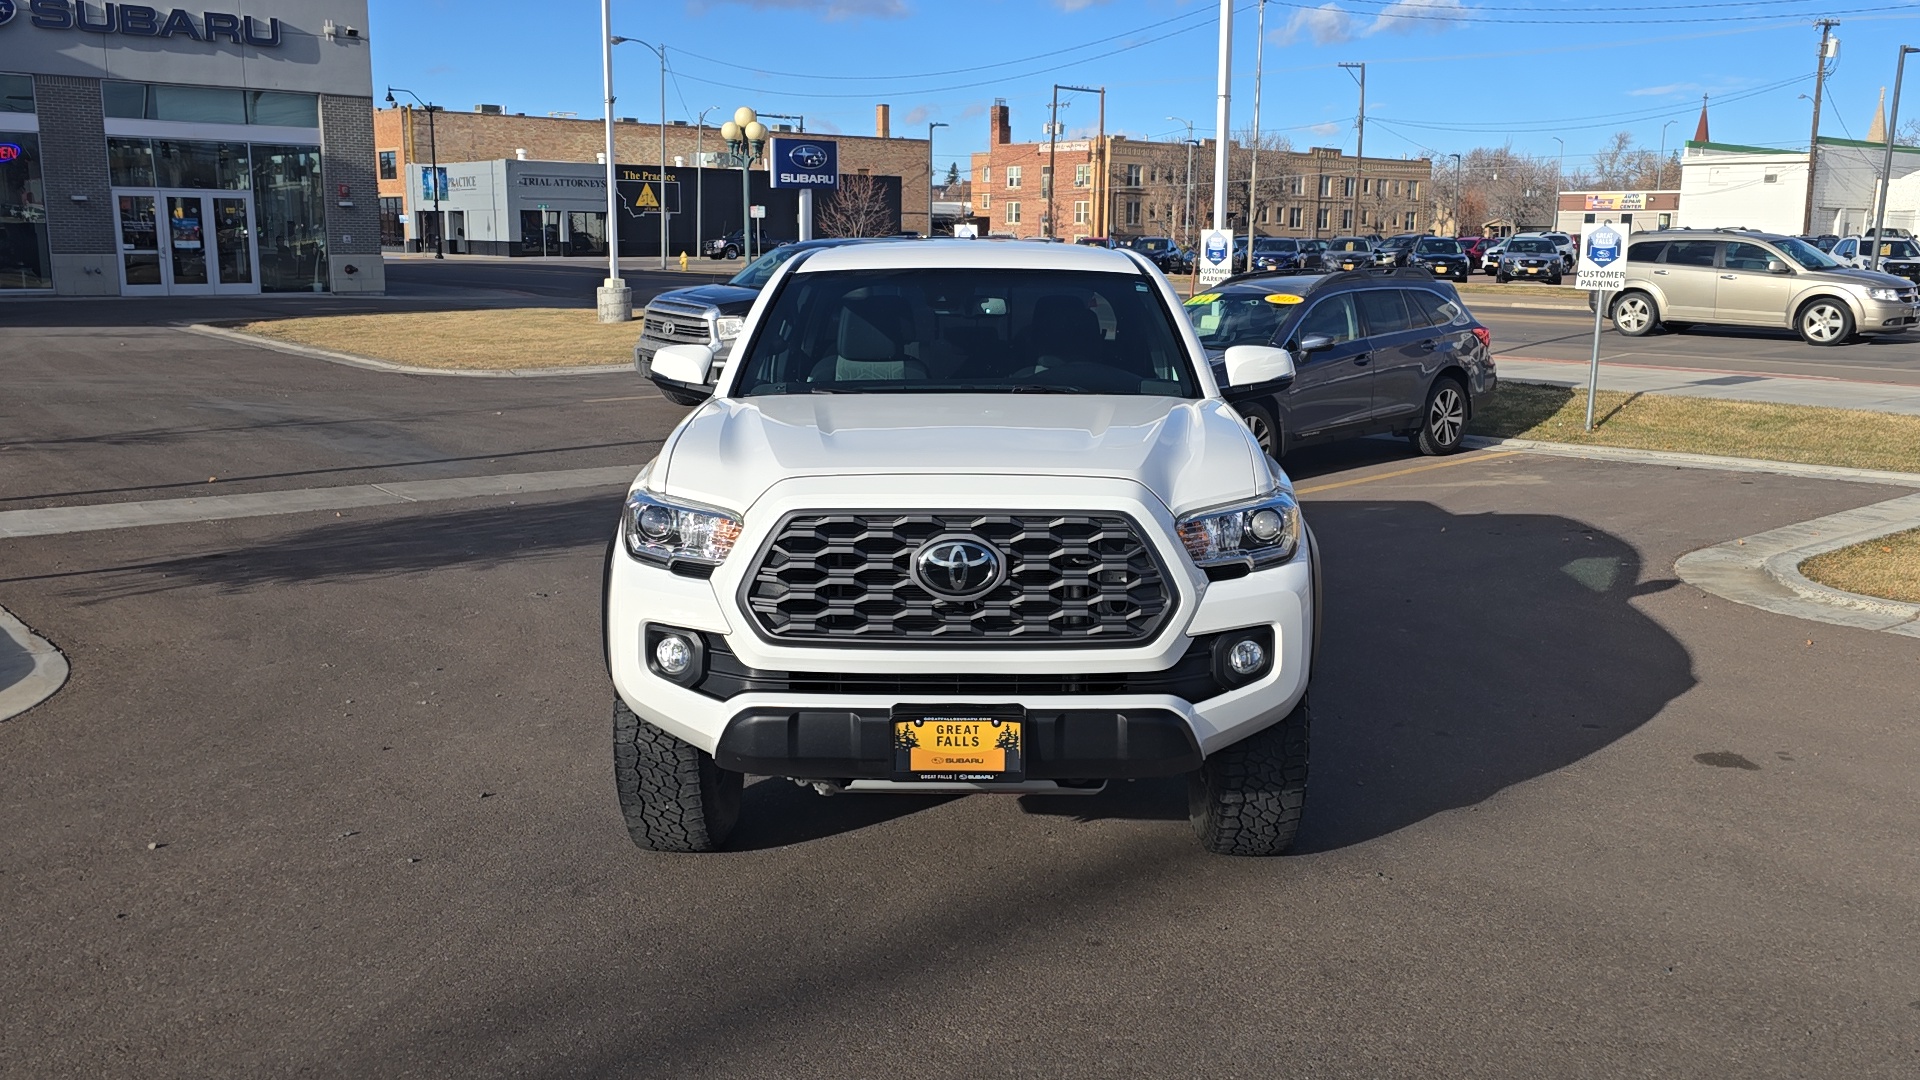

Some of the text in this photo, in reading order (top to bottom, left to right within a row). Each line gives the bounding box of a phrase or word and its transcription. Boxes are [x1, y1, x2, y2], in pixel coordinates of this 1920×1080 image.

[29, 0, 282, 47] SUBARU
[623, 170, 676, 181] The Pracice
[780, 173, 834, 184] SUBARU
[448, 176, 477, 188] PRACTICE
[522, 177, 606, 188] TRIAL ATTORNEYS
[1577, 270, 1626, 279] CUSTOMER
[1580, 279, 1620, 288] PARKING
[936, 725, 980, 735] GREAT
[936, 736, 980, 746] FALLS
